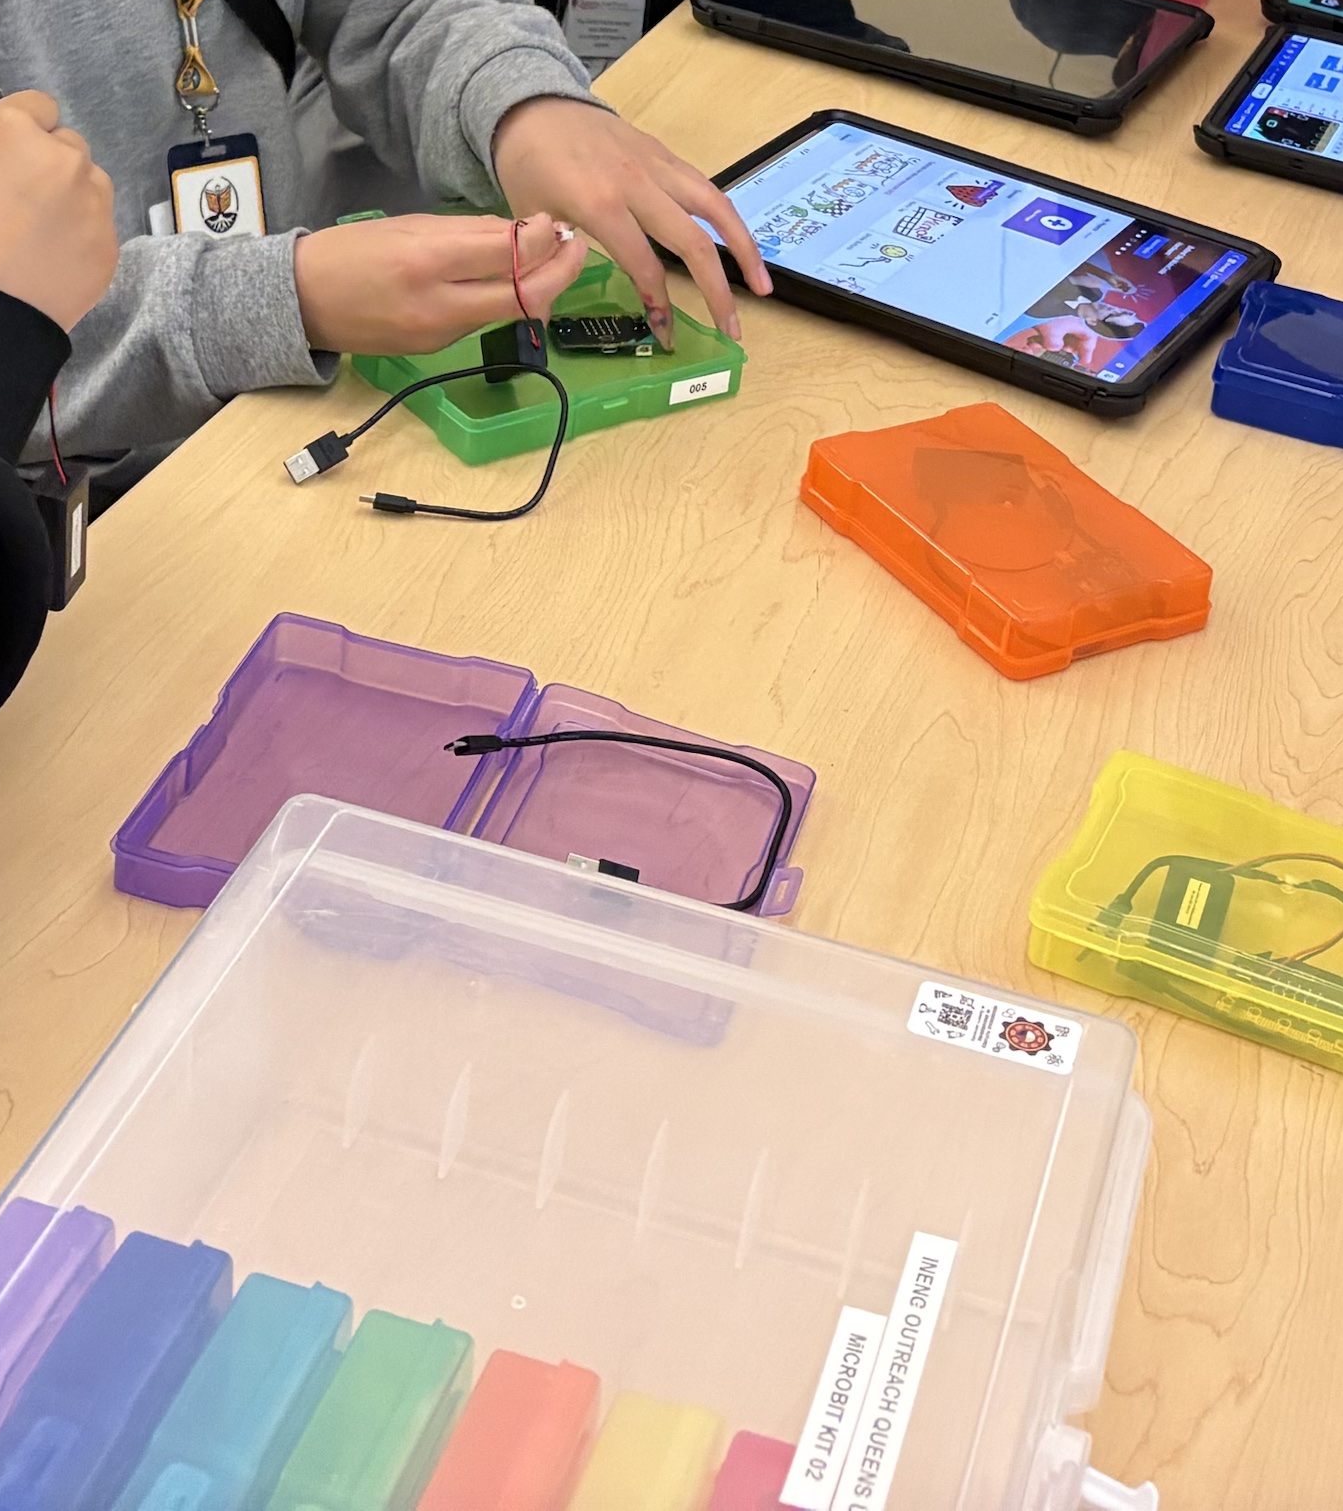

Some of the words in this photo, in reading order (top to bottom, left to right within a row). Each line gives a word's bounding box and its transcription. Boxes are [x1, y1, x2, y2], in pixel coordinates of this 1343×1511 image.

[689, 382, 707, 394] 005
[909, 1256, 939, 1309] INENG
[825, 1332, 867, 1423] MICROBIT
[878, 1313, 922, 1413] OUTREACH
[815, 1424, 839, 1457] KIT
[854, 1417, 892, 1498] QUEENS
[805, 1457, 827, 1482] 02
